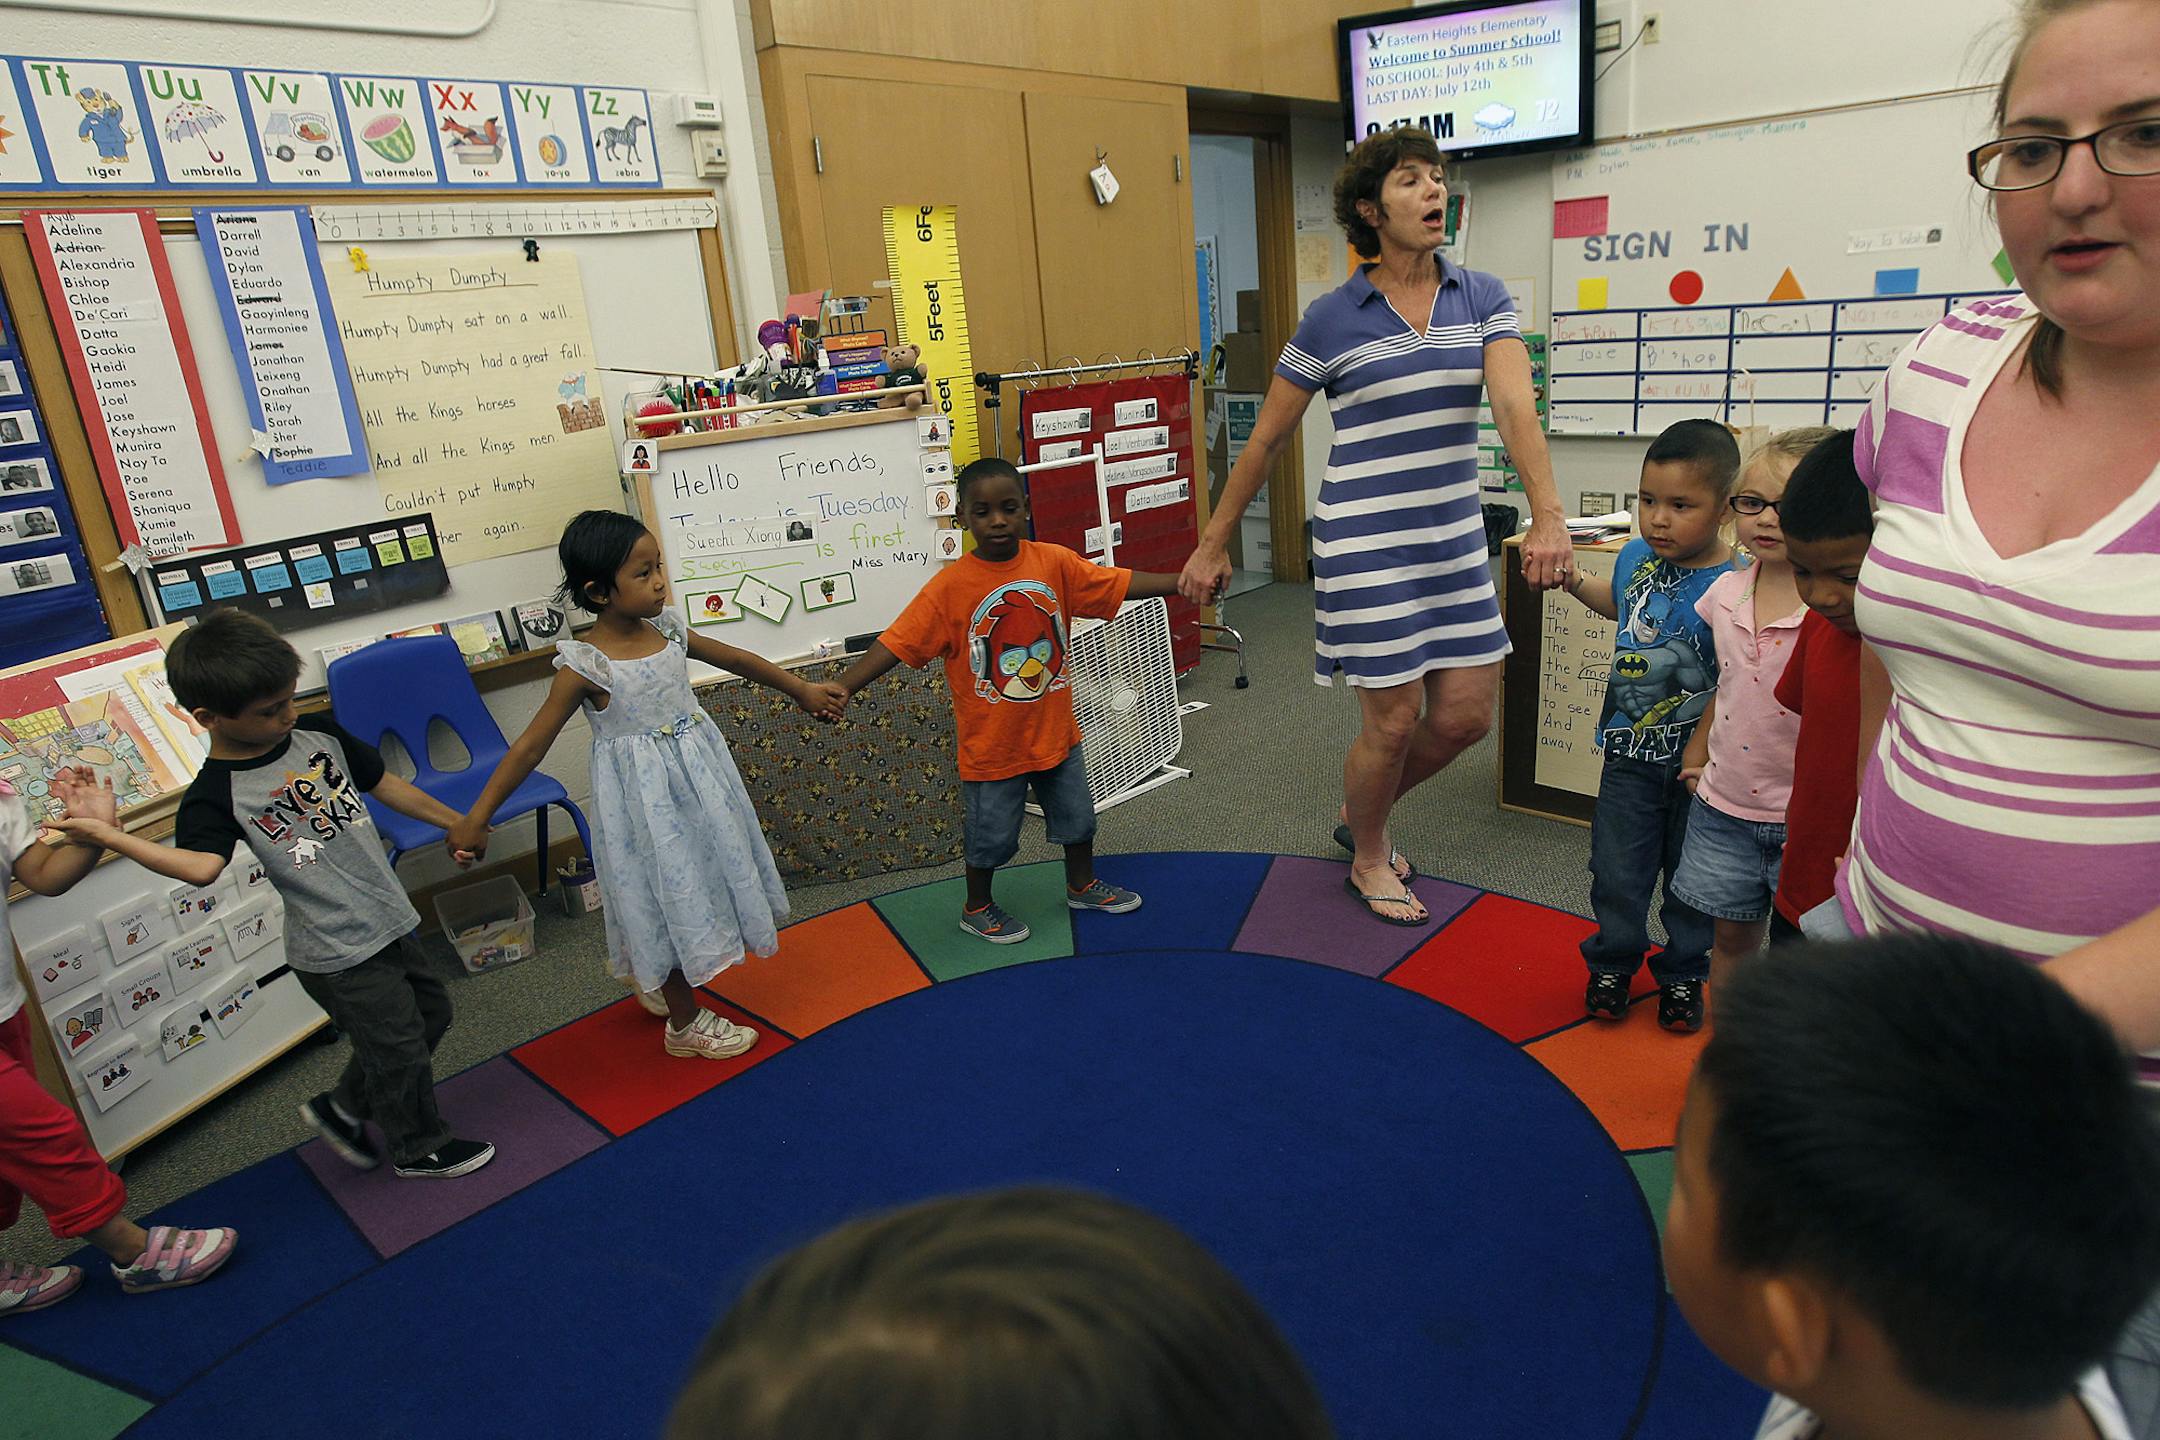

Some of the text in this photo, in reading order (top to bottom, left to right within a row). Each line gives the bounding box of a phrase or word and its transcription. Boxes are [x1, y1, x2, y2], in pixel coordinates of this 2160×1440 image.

[1387, 15, 1548, 47] Eastern Heights Elementary
[1369, 29, 1561, 67] Welcome to Summer School!
[1366, 53, 1533, 88] NO SCHOOL: July 4th & 5th
[30, 64, 72, 96] Tt
[147, 69, 203, 101] Uu
[250, 74, 300, 105] Vv
[343, 80, 404, 109] Ww
[432, 83, 478, 111] Xx
[1367, 79, 1491, 105] LAST DAY: July 12th
[513, 86, 552, 120] Yy
[588, 91, 620, 116] Zz
[87, 166, 122, 179] tiger
[182, 166, 242, 178] umbrella
[297, 167, 321, 177] van
[364, 168, 434, 179] watermelon
[472, 167, 491, 178] fox
[544, 168, 571, 179] yo-yo
[615, 168, 641, 178] zebra
[47, 212, 76, 226] Ayub
[49, 223, 103, 236] Adeline
[219, 229, 262, 242] Darrell
[331, 225, 342, 239] 0
[377, 227, 383, 237] 2
[398, 226, 405, 237] 3
[417, 225, 424, 236] 4
[431, 224, 438, 235] 5
[452, 223, 458, 233] 6
[470, 223, 476, 232] 7
[485, 222, 494, 236] 8
[506, 222, 512, 234] 9
[523, 222, 534, 232] 10
[544, 221, 552, 232] 11
[561, 221, 571, 231] 12
[54, 242, 103, 254] Adrian
[1584, 222, 1749, 262] SIGN IN
[224, 245, 260, 258] David
[59, 258, 135, 272] Alexandria
[227, 261, 264, 276] Dylan
[63, 276, 110, 290] Bishop
[232, 276, 283, 290] Eduardo
[367, 266, 507, 292] Humpty Dumpty
[69, 293, 110, 306] Chloe
[75, 307, 128, 322] De'Cari
[343, 304, 573, 340] Humpty Dumpty sat on a wall.
[81, 328, 119, 341] Datta
[86, 343, 136, 357] Gaokia
[91, 360, 127, 374] Heidi
[252, 353, 305, 367] Jonathan
[353, 343, 586, 385] Humpty Dumpty had a great fall.
[96, 378, 137, 391] James
[256, 370, 301, 383] Leixeng
[260, 384, 311, 398] Onathan
[101, 393, 129, 407] Joel
[264, 401, 293, 414] Riley
[106, 411, 135, 423] Jose
[365, 396, 516, 428] All the Kings horses
[268, 415, 302, 428] Sarah
[1035, 416, 1079, 436] Keyshawn
[110, 422, 177, 439] Keyshawn
[116, 440, 162, 454] Munira
[274, 446, 314, 459] Sophie
[375, 432, 559, 471] And all the Kings men.
[119, 455, 167, 471] Nay Ta
[124, 474, 149, 486] Poe
[672, 451, 885, 499] Hello Friends,
[128, 487, 173, 502] Serena
[385, 473, 536, 513] Couldn't put Humpty
[133, 500, 192, 517] Shaniqua
[808, 490, 914, 519] Tuesday.
[138, 518, 176, 532] Xumie
[483, 517, 525, 538] again.
[142, 530, 195, 547] Yamileth
[686, 526, 782, 550] Suechi Xiong
[848, 521, 911, 549] first.
[147, 543, 185, 557] Suechi
[851, 550, 929, 570] Miss Mary
[1548, 598, 1569, 620] Hey
[1545, 616, 1607, 640] The cat
[1544, 635, 1612, 660] The cow
[1546, 656, 1571, 674] the
[1543, 673, 1569, 692] The
[1543, 694, 1591, 716] to see
[1543, 712, 1572, 731] And
[1541, 736, 1573, 753] away
[308, 750, 346, 791] 2
[121, 916, 135, 928] Sign
[53, 948, 69, 960] Meal
[172, 934, 215, 957] Active Learning
[121, 972, 161, 996] Small Groups
